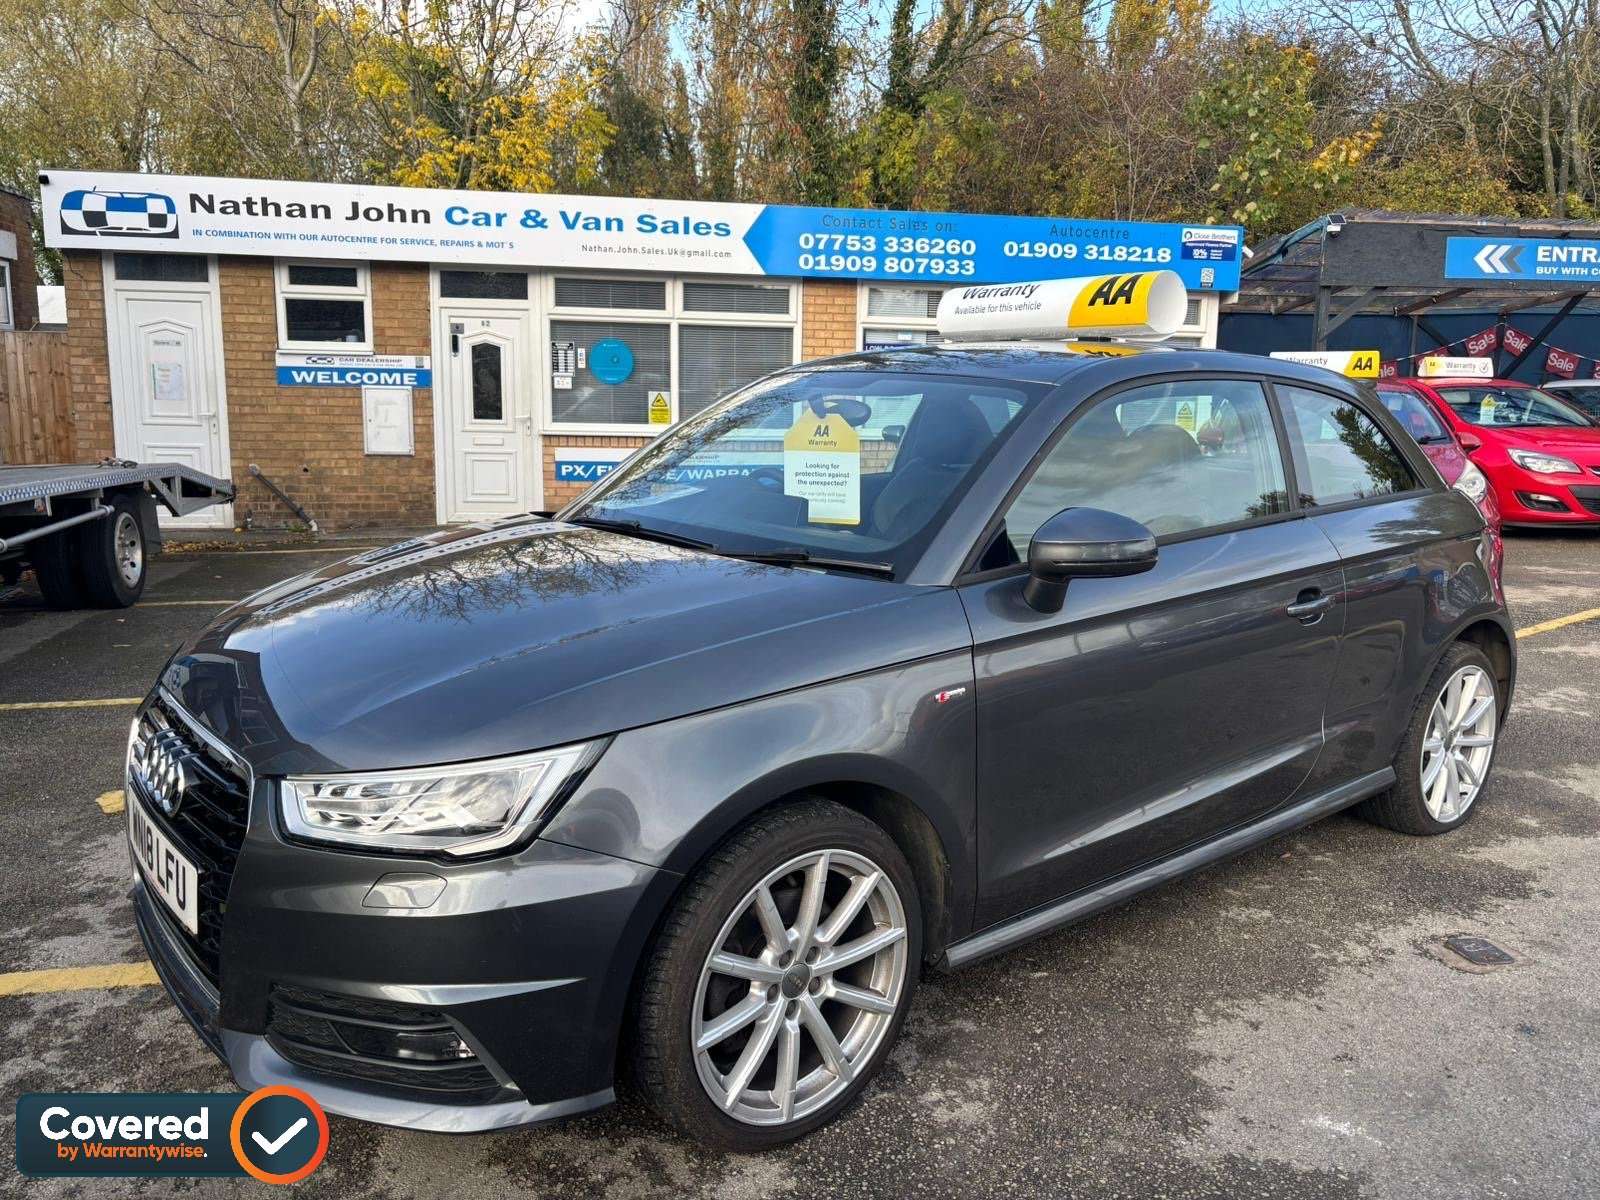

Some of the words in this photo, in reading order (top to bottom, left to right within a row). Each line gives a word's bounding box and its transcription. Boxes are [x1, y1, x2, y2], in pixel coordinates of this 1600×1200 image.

[188, 193, 332, 219] Nathan
[345, 201, 431, 224] John
[444, 205, 507, 227] Car
[519, 209, 548, 229] &
[559, 210, 624, 232] Van
[636, 214, 731, 237] Sales
[822, 215, 883, 229] Contact
[889, 219, 928, 231] Sales
[192, 228, 202, 237] IN
[204, 229, 271, 240] COMBINATION
[273, 232, 298, 240] WITH
[299, 233, 318, 241] OUR
[320, 234, 378, 244] AUTOCENTRE
[380, 237, 397, 245] FOR
[399, 237, 438, 247] SERVICE,
[439, 239, 475, 248] REPAIRS
[477, 240, 483, 248] &
[1050, 223, 1130, 239] Autocentre
[799, 233, 876, 251] 07753
[883, 236, 977, 255] 336260
[1003, 241, 1078, 259] 01909
[1084, 244, 1171, 263] 318218
[1536, 246, 1600, 263] ENTR
[799, 254, 877, 272] 01909
[884, 257, 975, 275] 807933
[1536, 266, 1558, 275] BUY
[1561, 267, 1588, 275] WITH
[962, 282, 1041, 300] Warranty
[1088, 273, 1144, 306] AA
[955, 303, 985, 315] Available
[987, 304, 999, 312] for
[998, 304, 1012, 312] this
[1014, 301, 1042, 311] vehicle
[1469, 333, 1497, 354] Sale
[1504, 330, 1528, 352] Sale
[1352, 357, 1373, 371] AA
[1548, 353, 1574, 372] Sale
[292, 371, 418, 385] WELCOME
[814, 425, 830, 437] AA
[808, 439, 838, 447] Warranty
[156, 837, 186, 911] LFU
